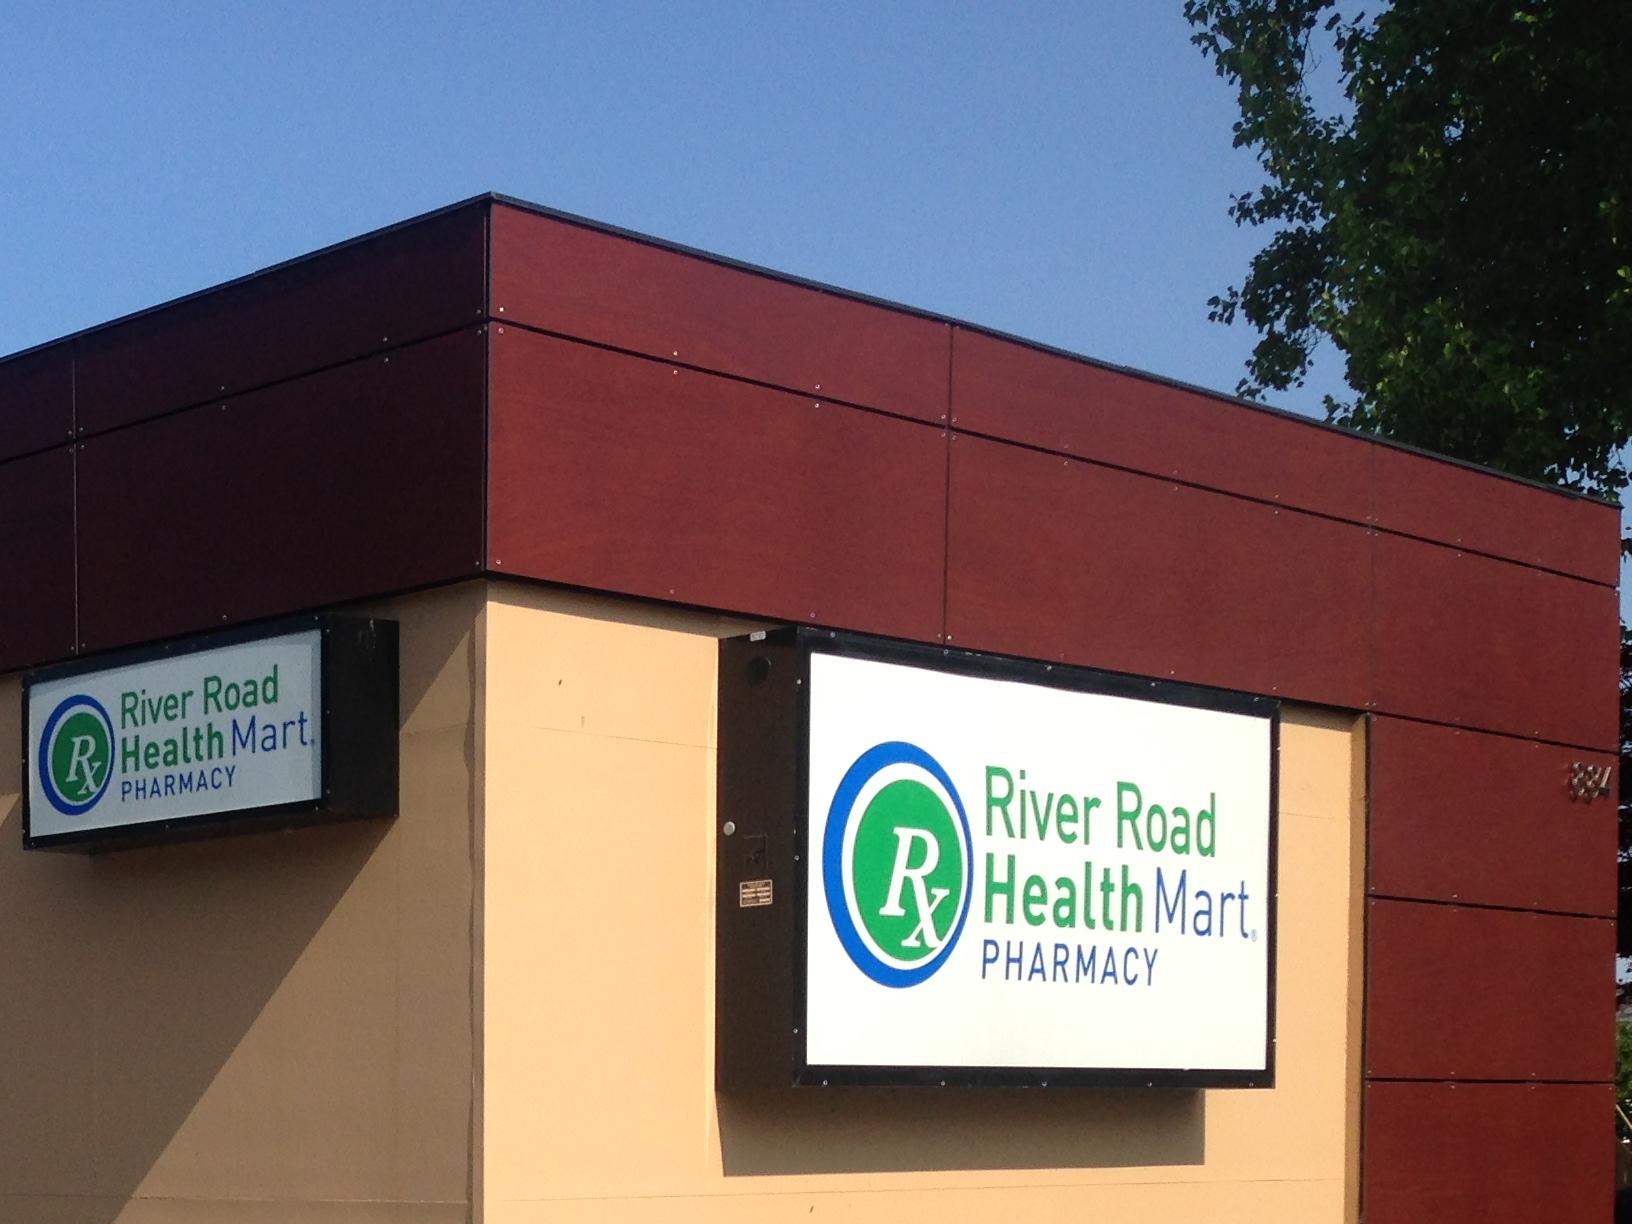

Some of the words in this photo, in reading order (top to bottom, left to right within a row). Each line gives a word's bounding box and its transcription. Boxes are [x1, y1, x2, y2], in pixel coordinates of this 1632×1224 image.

[121, 690, 194, 729] River
[203, 664, 279, 714] Road
[121, 765, 236, 802] PHARMACY
[984, 765, 1101, 844] River
[1117, 782, 1216, 857] Road
[981, 940, 1159, 987] PHARMACY
